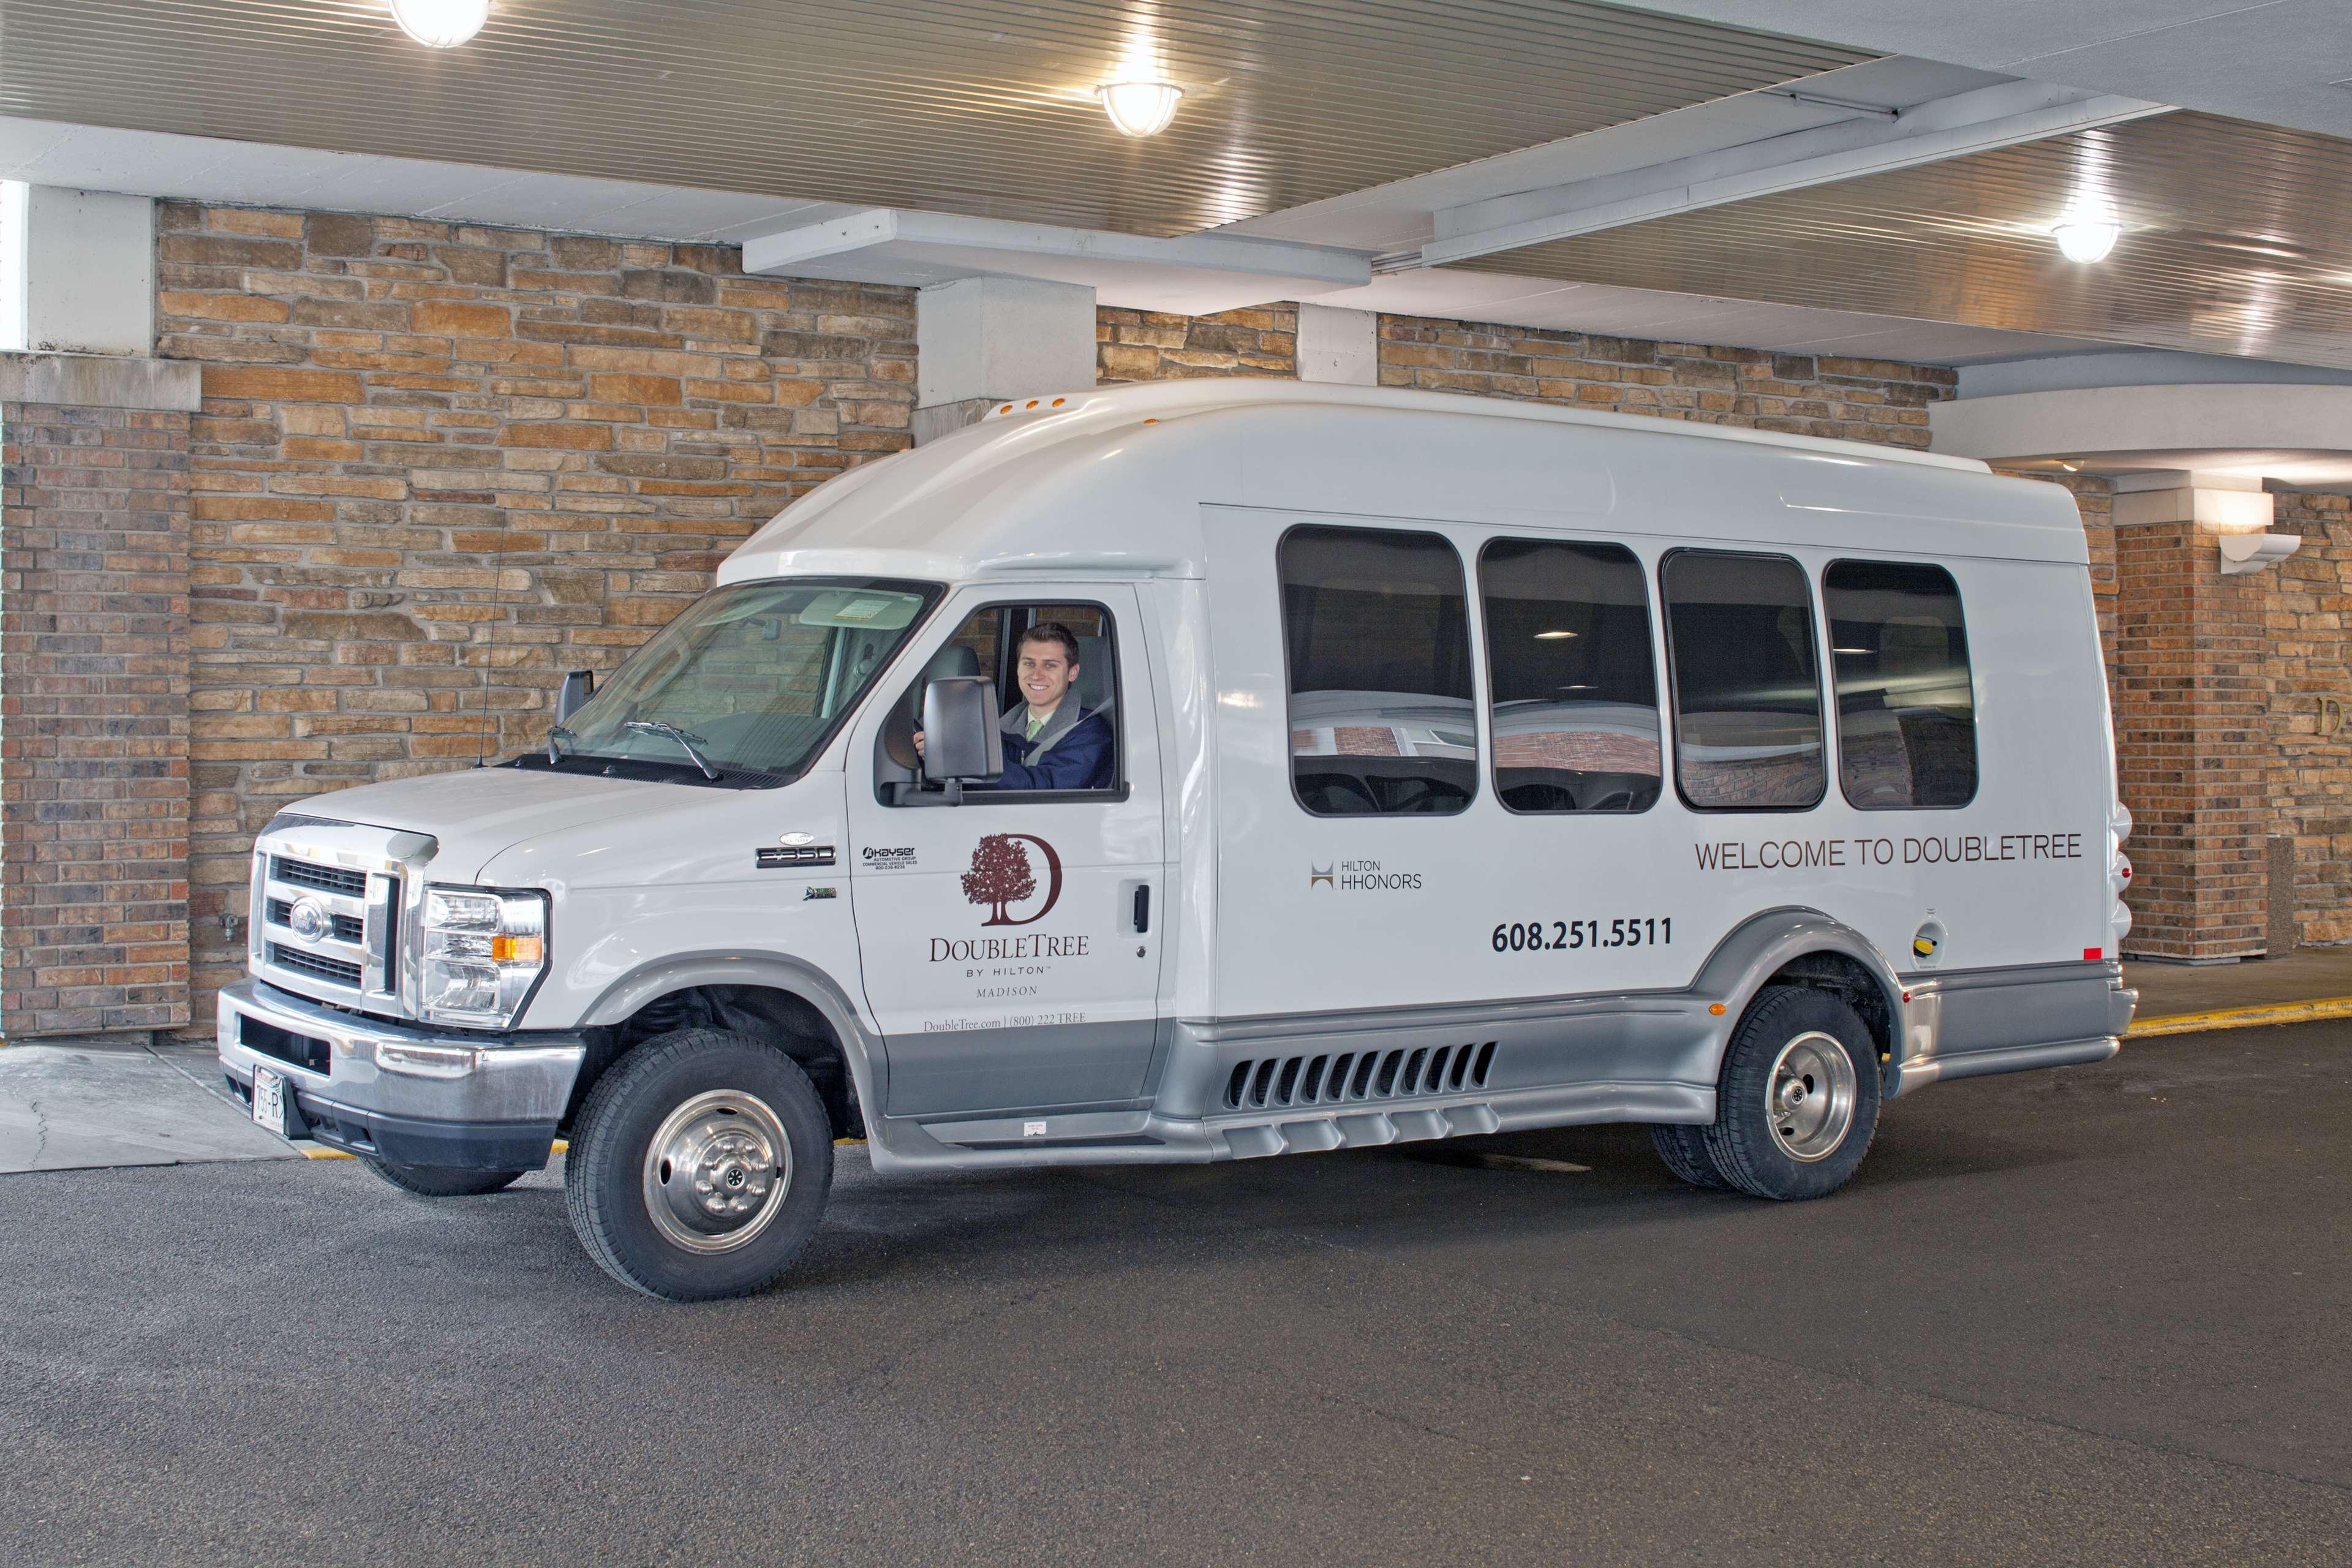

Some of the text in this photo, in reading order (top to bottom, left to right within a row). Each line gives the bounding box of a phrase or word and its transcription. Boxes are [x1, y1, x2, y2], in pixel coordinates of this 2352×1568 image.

[2316, 696, 2343, 736] D
[1695, 833, 2082, 870] WELCOME TO DOUBLETREE
[1341, 860, 1381, 872] HILTON
[1341, 874, 1422, 890] HHONORS
[1492, 918, 1671, 952] 608.251.5511
[966, 968, 984, 978] BY
[976, 986, 1038, 998] MADISON
[924, 1012, 1087, 1032] DoubleTree.com (800) 222 TREE
